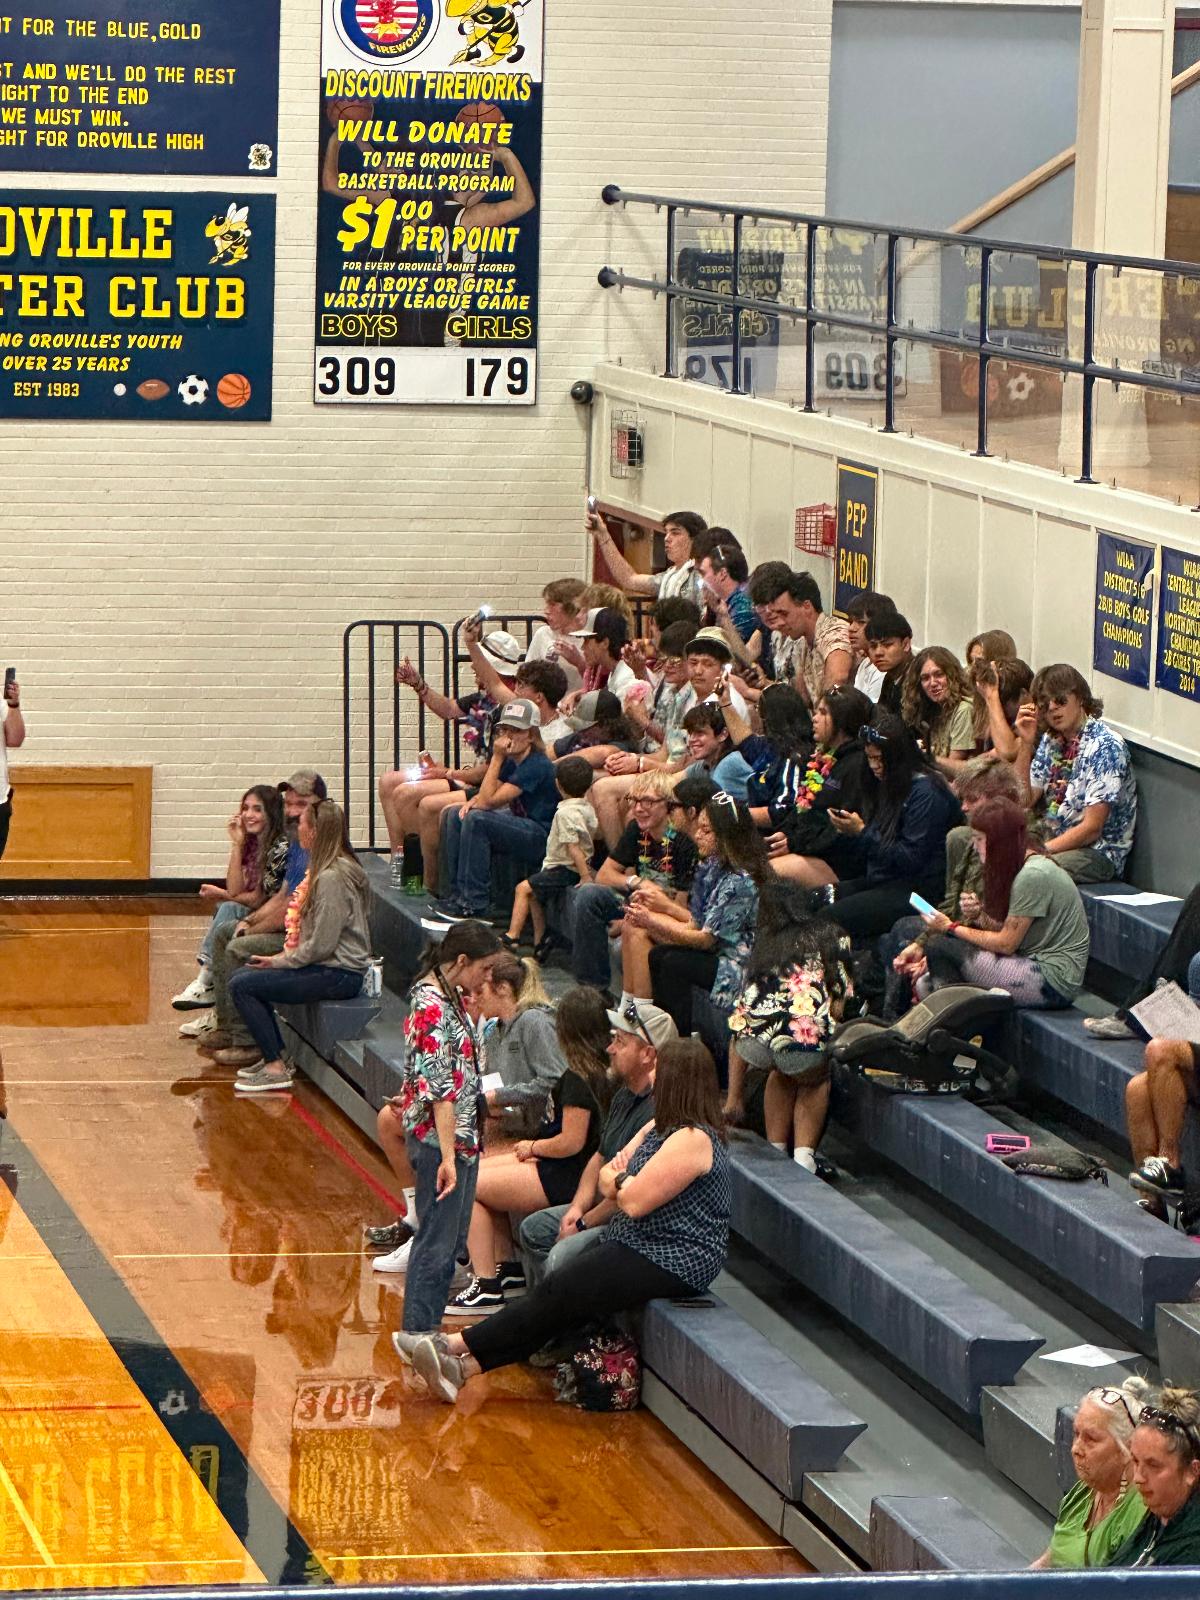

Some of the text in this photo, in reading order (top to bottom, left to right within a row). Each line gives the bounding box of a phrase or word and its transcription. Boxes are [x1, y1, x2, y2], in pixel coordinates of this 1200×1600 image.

[22, 17, 54, 36] FOR
[66, 20, 96, 37] THE
[368, 13, 426, 54] FIREWORKS
[23, 63, 57, 80] AND
[65, 64, 115, 82] WE'LL
[125, 65, 147, 82] DO
[155, 66, 185, 84] THE
[194, 67, 236, 85] REST
[325, 69, 534, 101] DISCOUNT FIREWORKS
[47, 85, 69, 103] TO
[79, 86, 109, 104] THE
[117, 87, 149, 105] END
[1, 107, 129, 127] WE MUST WIN.
[36, 131, 68, 147] FOR
[77, 131, 158, 149] OROVILLE
[166, 133, 204, 150] HIGH
[337, 119, 514, 144] WILL DONATE
[362, 151, 491, 169] TO THE OROVILLE
[337, 173, 515, 192] BASKETBALL PROGRAM
[401, 226, 520, 253] PER POINT
[342, 261, 515, 272] FOR EVERY OROVILLE POINT SCORED
[340, 276, 517, 294] IN A BOYS OR GIRLS
[109, 276, 245, 319] CLUB
[324, 293, 530, 310] VARSITY LEAGUE GAME
[321, 314, 532, 340] BOYS GIRLS
[127, 334, 183, 350] YOUTH
[3, 356, 131, 372] OVER 25 YEARS
[318, 356, 396, 396] 309
[466, 356, 529, 397] 179
[13, 382, 80, 397] EST 1983
[846, 500, 867, 538] PEP
[839, 548, 868, 589] BAND
[1103, 570, 1133, 596] DISTRICT
[1167, 573, 1195, 597] CENTRAL
[1132, 606, 1150, 626] GOLF
[1103, 621, 1143, 649] CHAMPIONS
[1113, 649, 1130, 671] 2014
[1179, 673, 1195, 695] 2014
